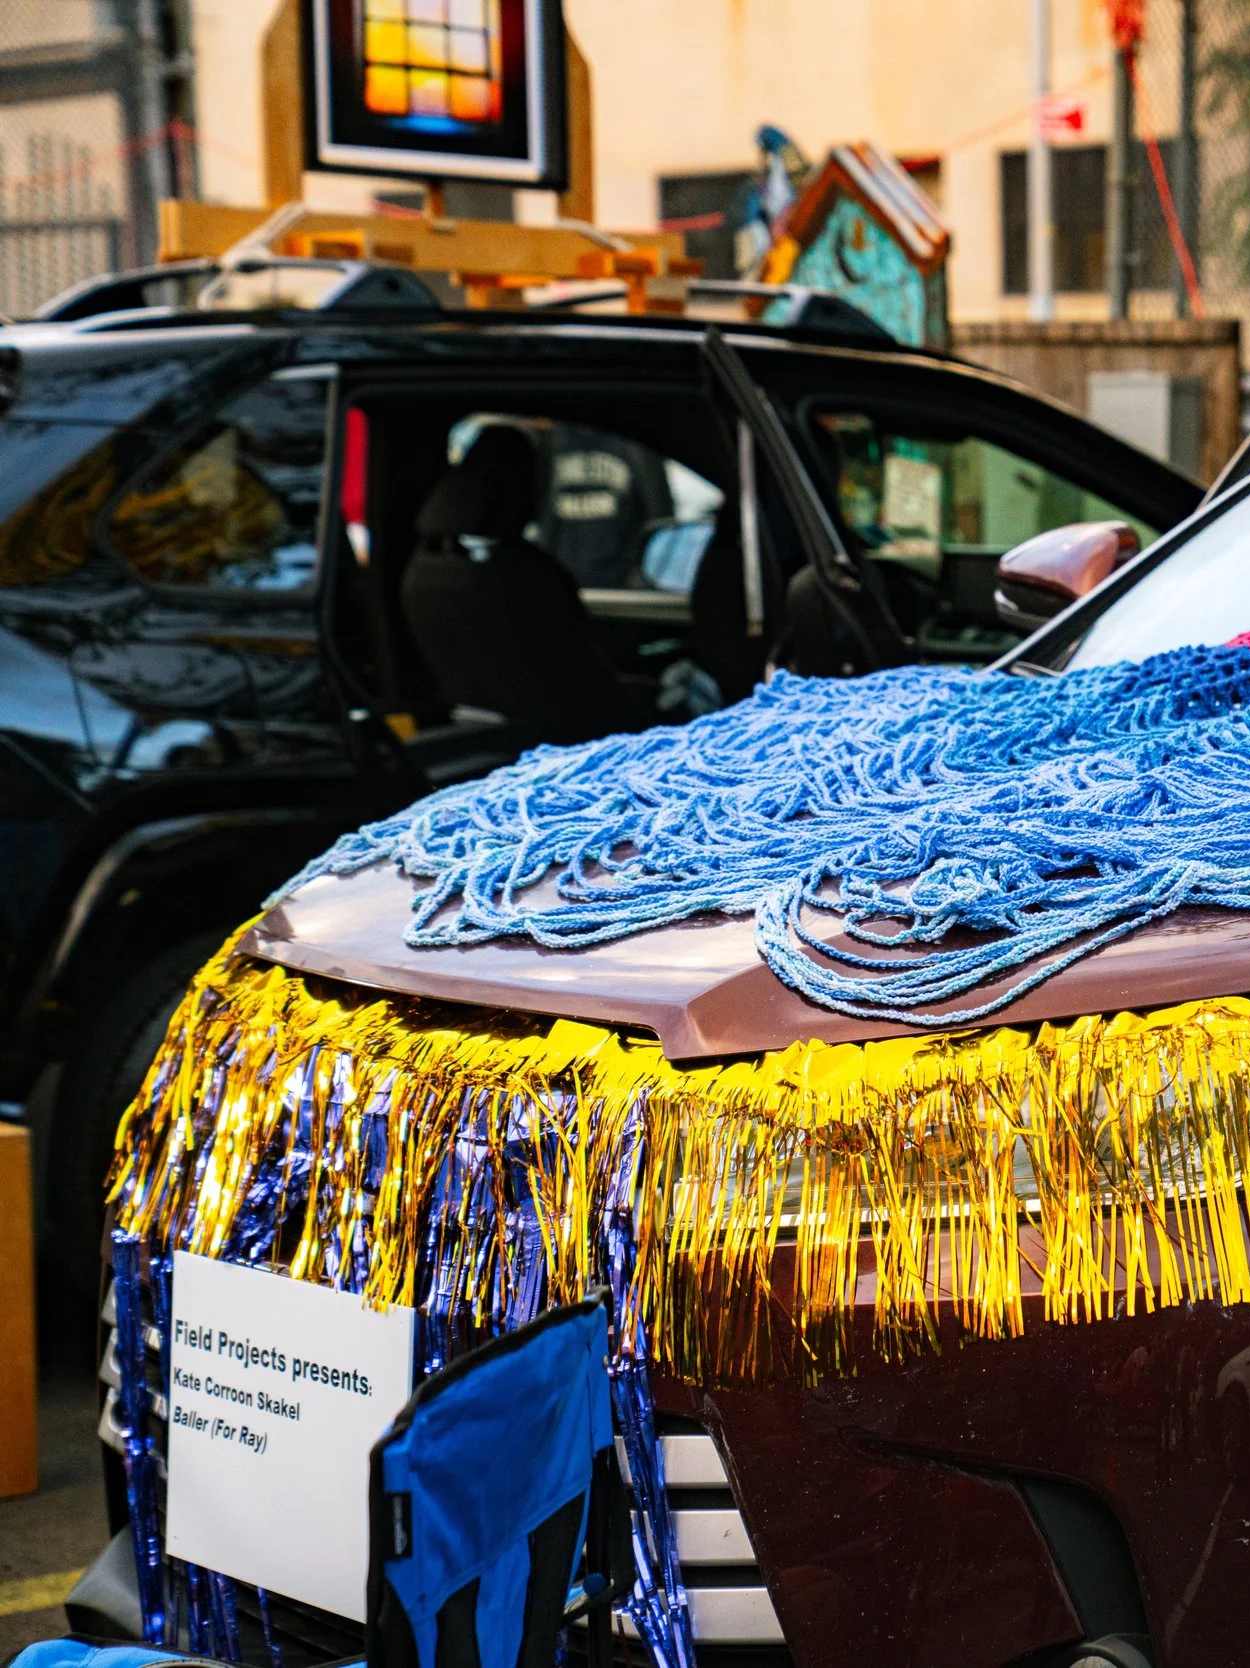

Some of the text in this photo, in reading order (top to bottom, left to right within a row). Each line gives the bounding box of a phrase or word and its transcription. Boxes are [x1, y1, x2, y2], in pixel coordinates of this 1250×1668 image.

[174, 1319, 373, 1397] Field Projects presents:
[173, 1367, 301, 1421] Kate Corroon Skakel
[172, 1405, 268, 1455] Baller (For Ray)
